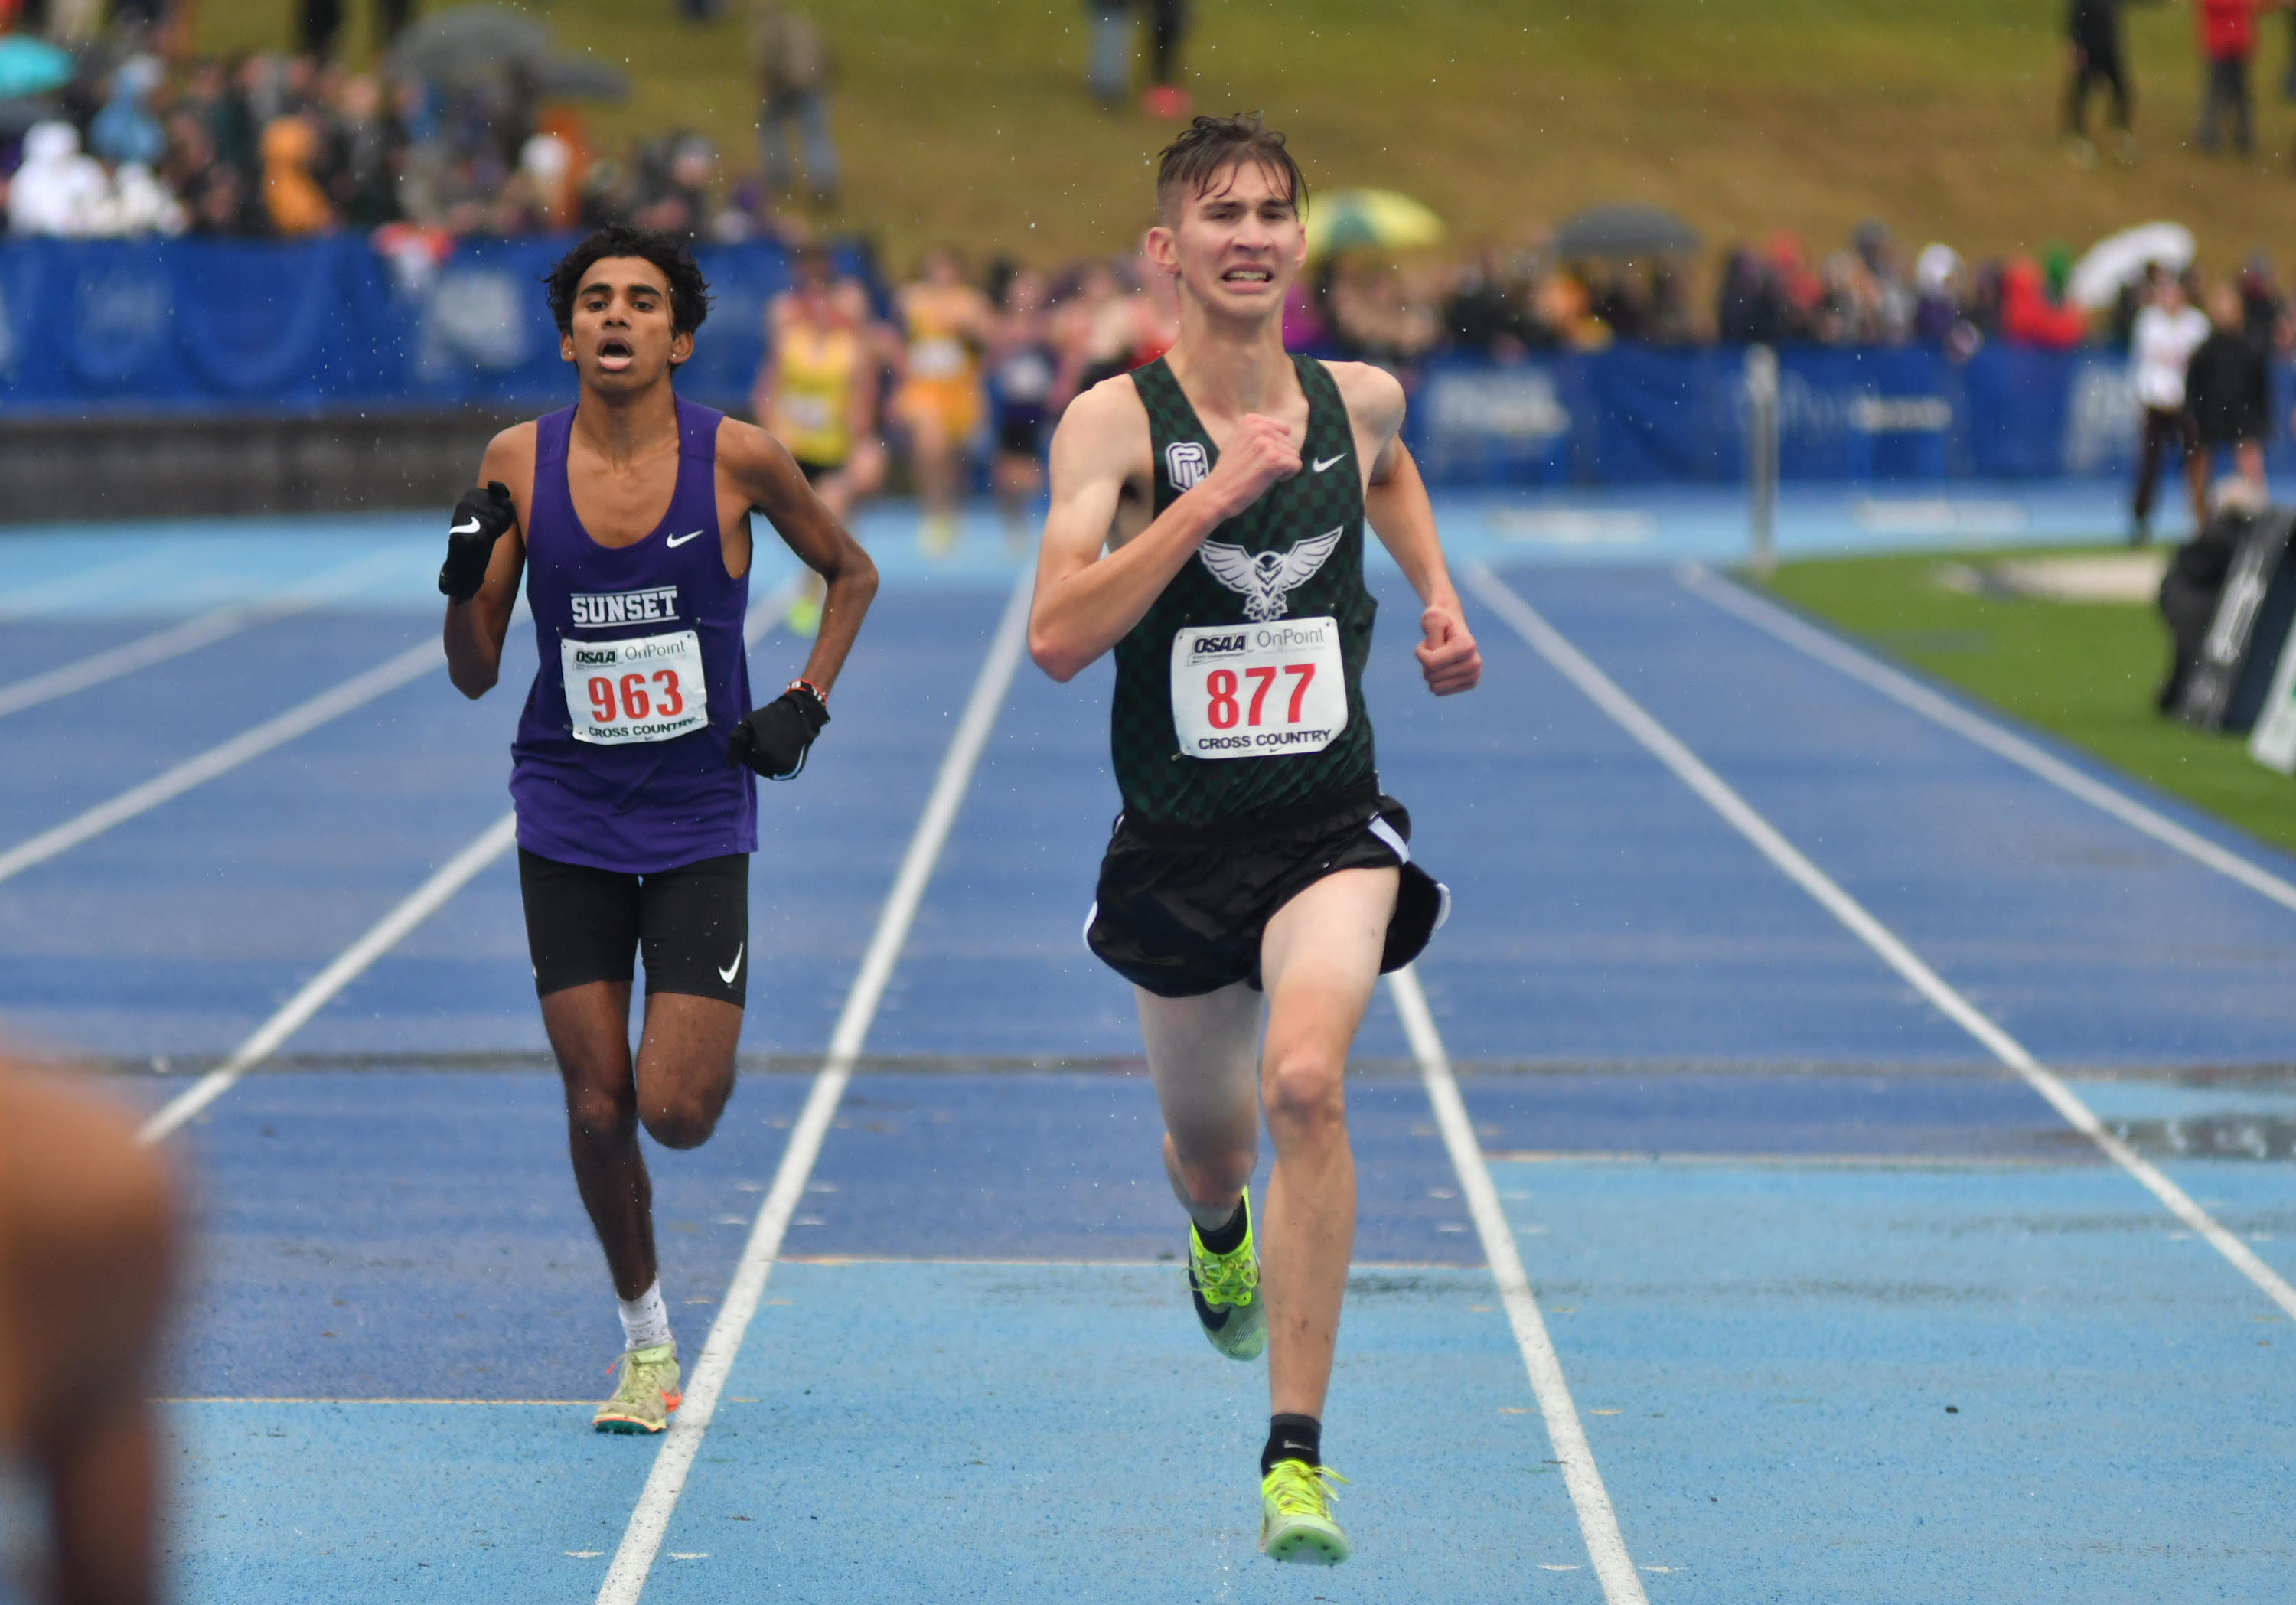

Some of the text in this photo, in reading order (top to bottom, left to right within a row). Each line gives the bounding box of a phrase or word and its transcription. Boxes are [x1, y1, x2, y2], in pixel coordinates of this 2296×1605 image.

[571, 589, 678, 624] SUNSET
[576, 650, 616, 664] OSAA
[625, 640, 686, 661] OnPoint
[1193, 634, 1247, 654] OSAA
[1257, 628, 1325, 648] OnPoint
[588, 670, 683, 723] 963
[1206, 663, 1316, 729] 877
[589, 717, 696, 739] CROSS COUNTRY
[1199, 729, 1332, 750] CROSS COUNTRY
